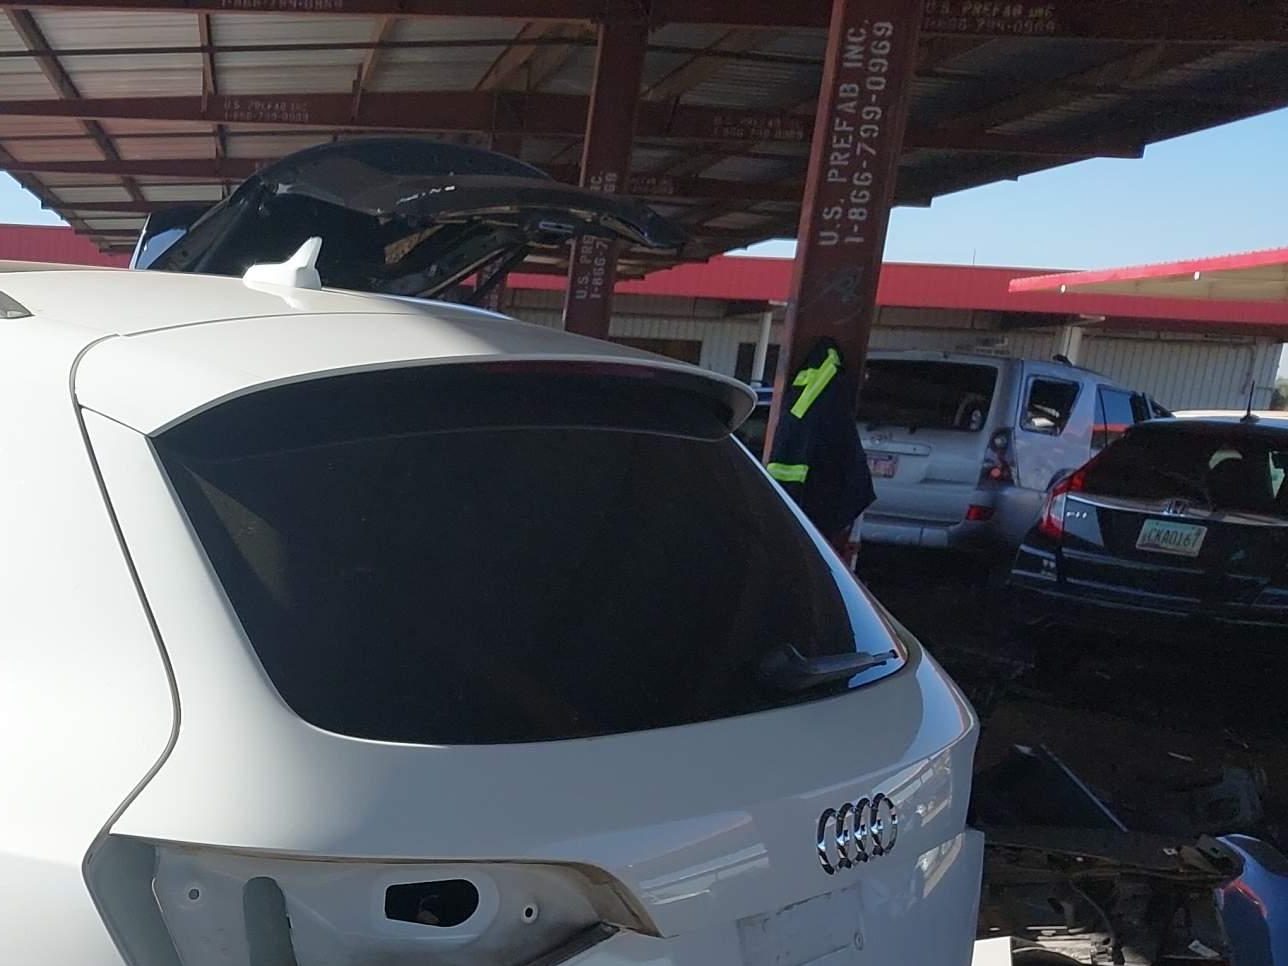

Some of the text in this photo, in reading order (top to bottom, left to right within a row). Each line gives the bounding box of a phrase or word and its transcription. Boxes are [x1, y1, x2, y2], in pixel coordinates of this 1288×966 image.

[819, 19, 870, 246] U.S. PREFAB INC.
[844, 21, 894, 244] 1-866-799-0969
[580, 234, 595, 265] PRE
